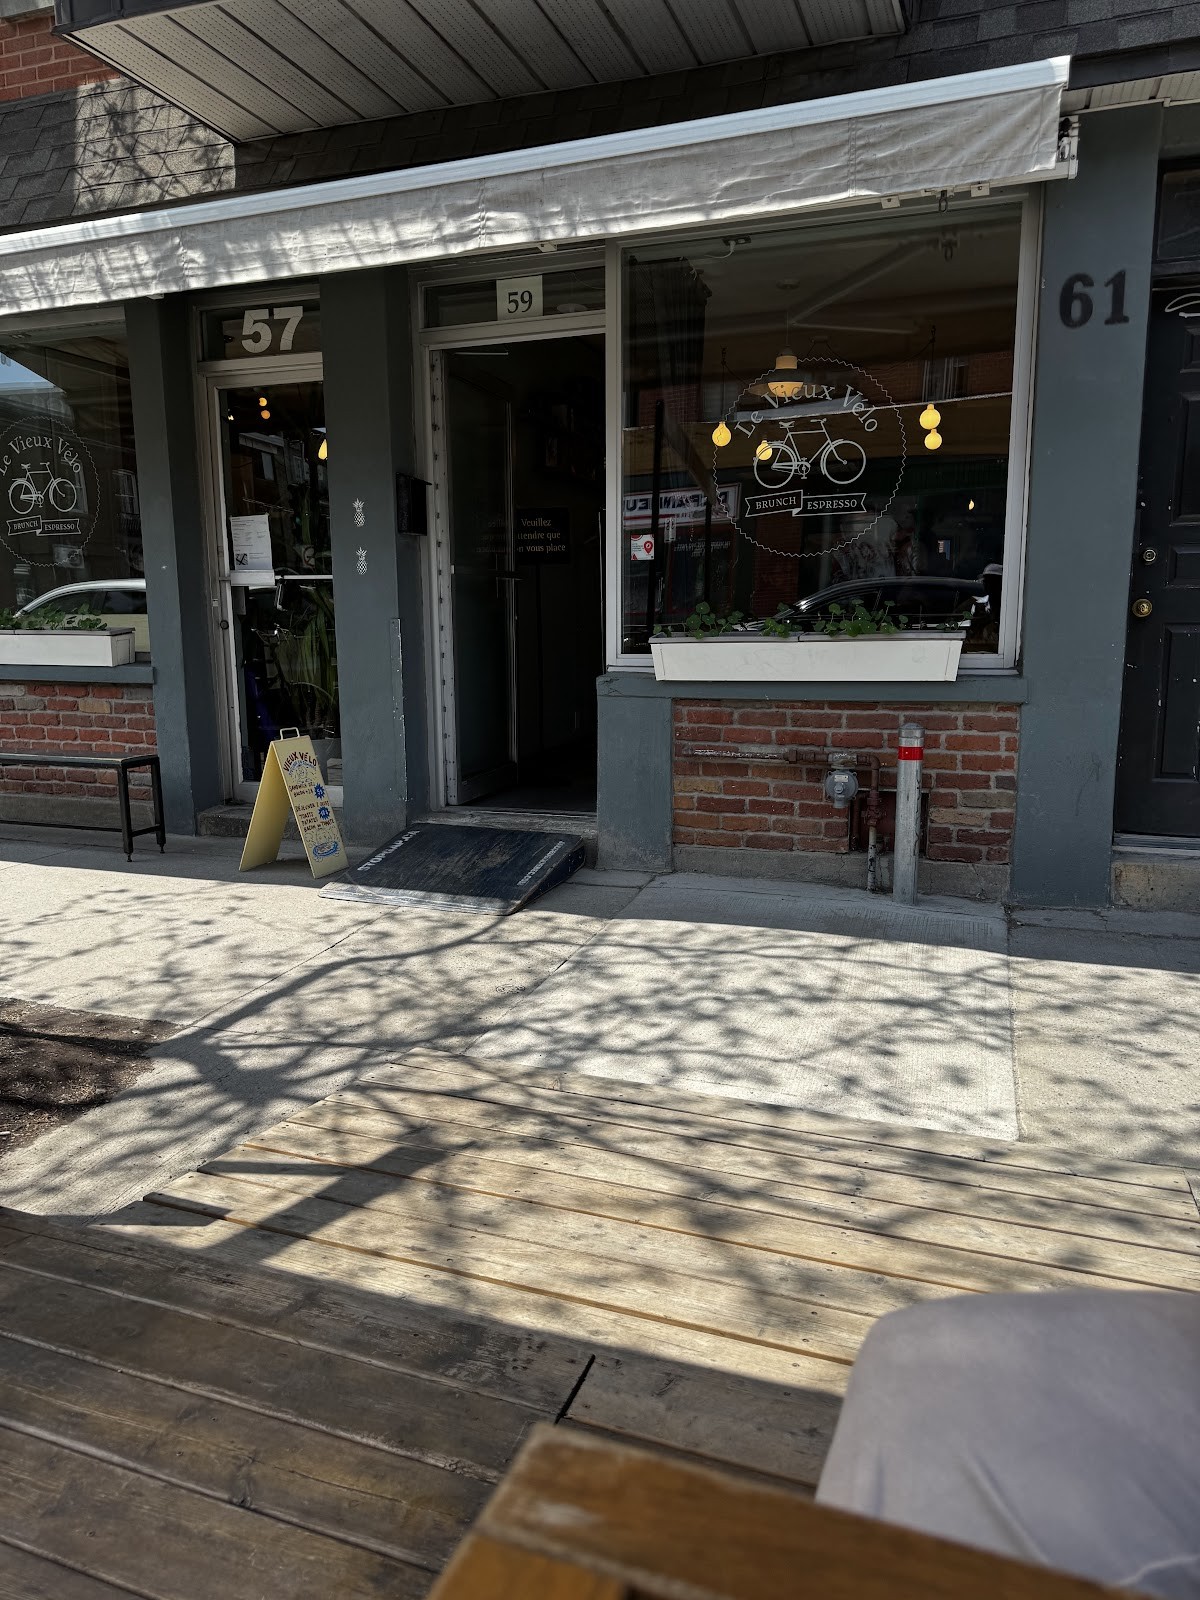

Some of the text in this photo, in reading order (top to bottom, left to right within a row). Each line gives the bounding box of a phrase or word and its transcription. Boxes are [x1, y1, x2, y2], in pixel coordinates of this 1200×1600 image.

[507, 290, 533, 315] 59
[1059, 269, 1130, 329] 61
[241, 306, 304, 354] 57
[734, 384, 878, 438] Le Vieux Vélo
[0, 436, 81, 476] Le Vieux Vélo
[755, 497, 857, 510] BRUNCH ESPRESSO
[13, 520, 75, 531] BRUNCH ESPRESSO
[521, 518, 552, 528] Veuillez
[516, 531, 561, 542] ttendre que
[526, 545, 544, 553] vous
[546, 543, 566, 554] place
[283, 752, 299, 772] VIEUX
[299, 751, 317, 766] VÉLO
